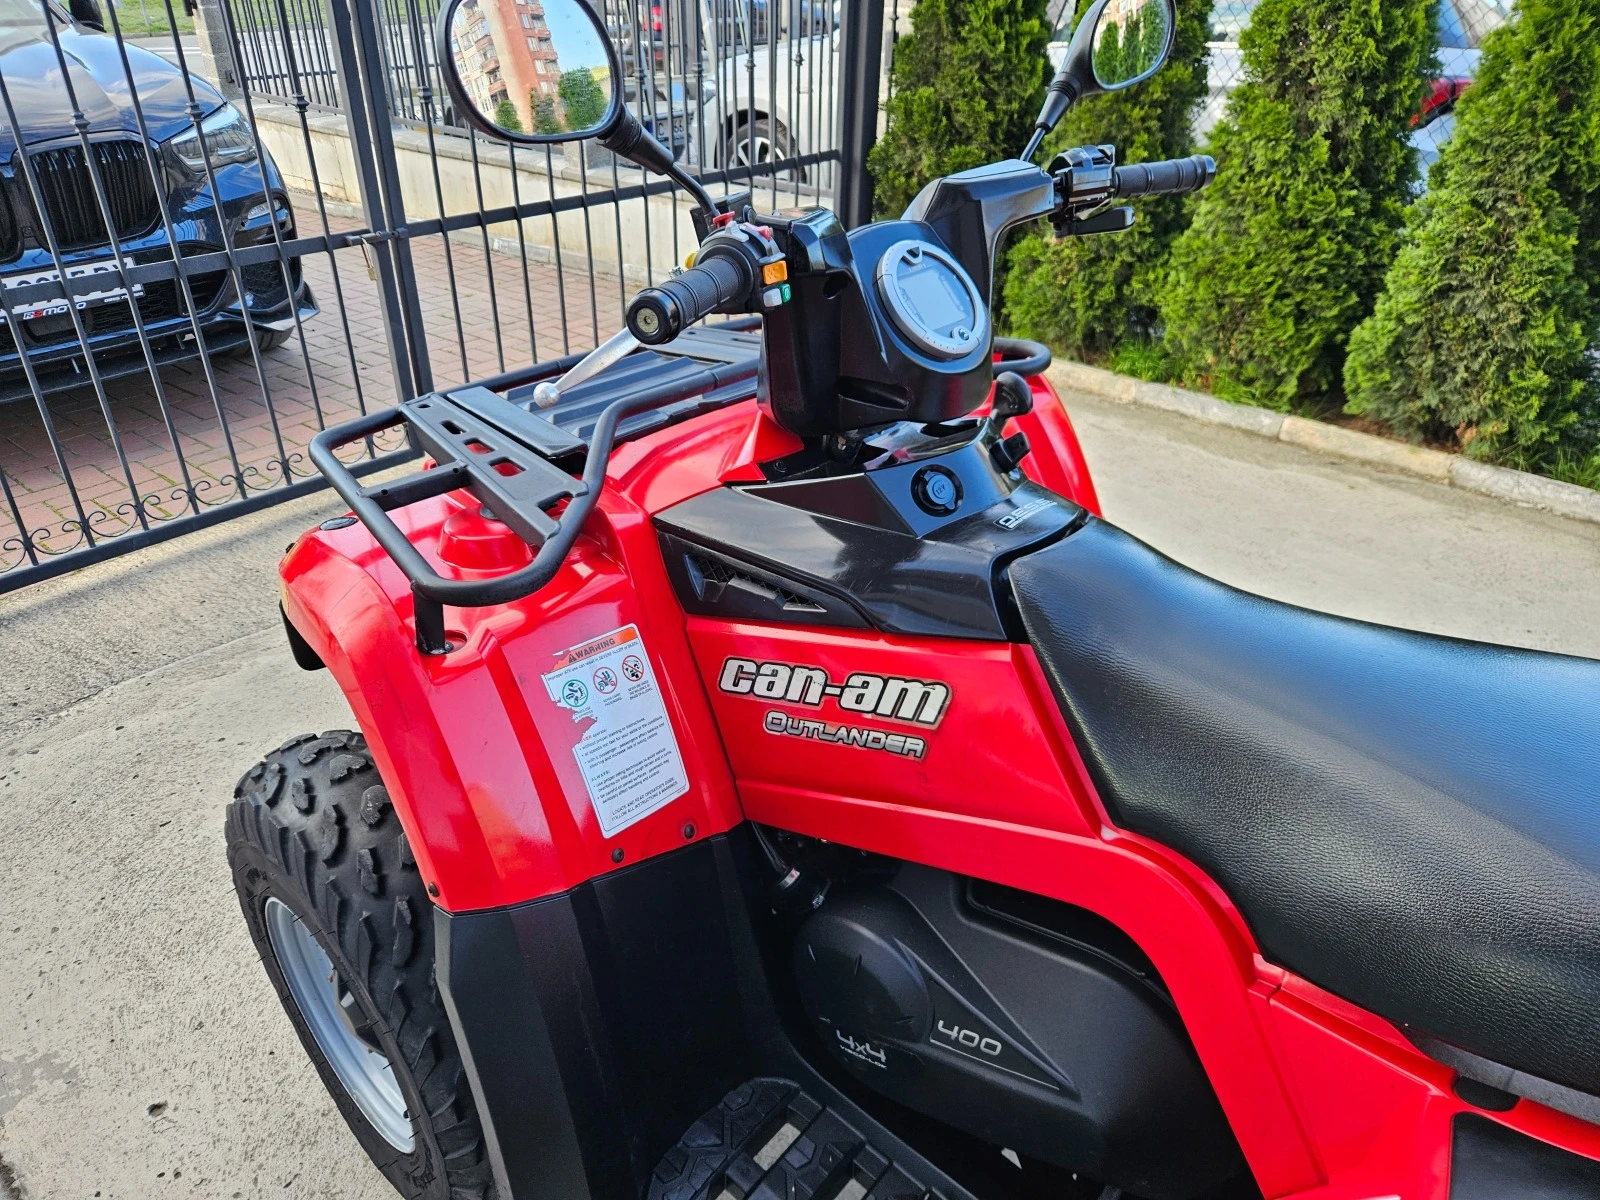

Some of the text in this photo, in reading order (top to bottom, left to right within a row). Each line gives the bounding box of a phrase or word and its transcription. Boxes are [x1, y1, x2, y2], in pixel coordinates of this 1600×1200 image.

[575, 638, 616, 659] WARNING
[612, 805, 626, 815] LOCATE
[836, 1029, 887, 1063] 4x4
[937, 1019, 1002, 1056] 400
